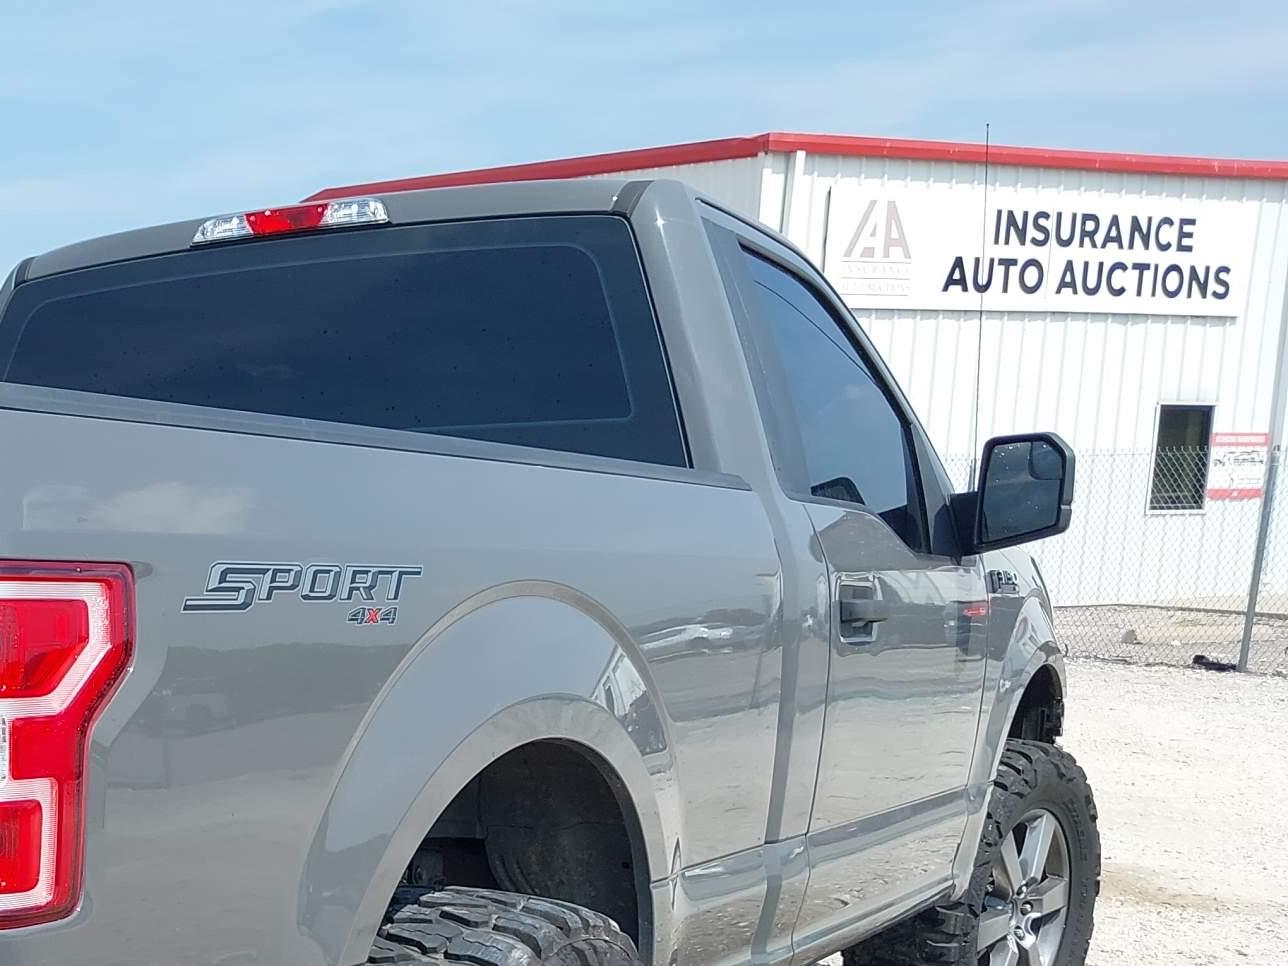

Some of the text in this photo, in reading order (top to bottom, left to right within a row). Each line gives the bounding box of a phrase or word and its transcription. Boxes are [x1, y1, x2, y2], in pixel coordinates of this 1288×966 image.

[993, 208, 1196, 252] INSURANCE
[941, 255, 1231, 300] AUTO AUCTIONS
[181, 560, 423, 612] SPORT
